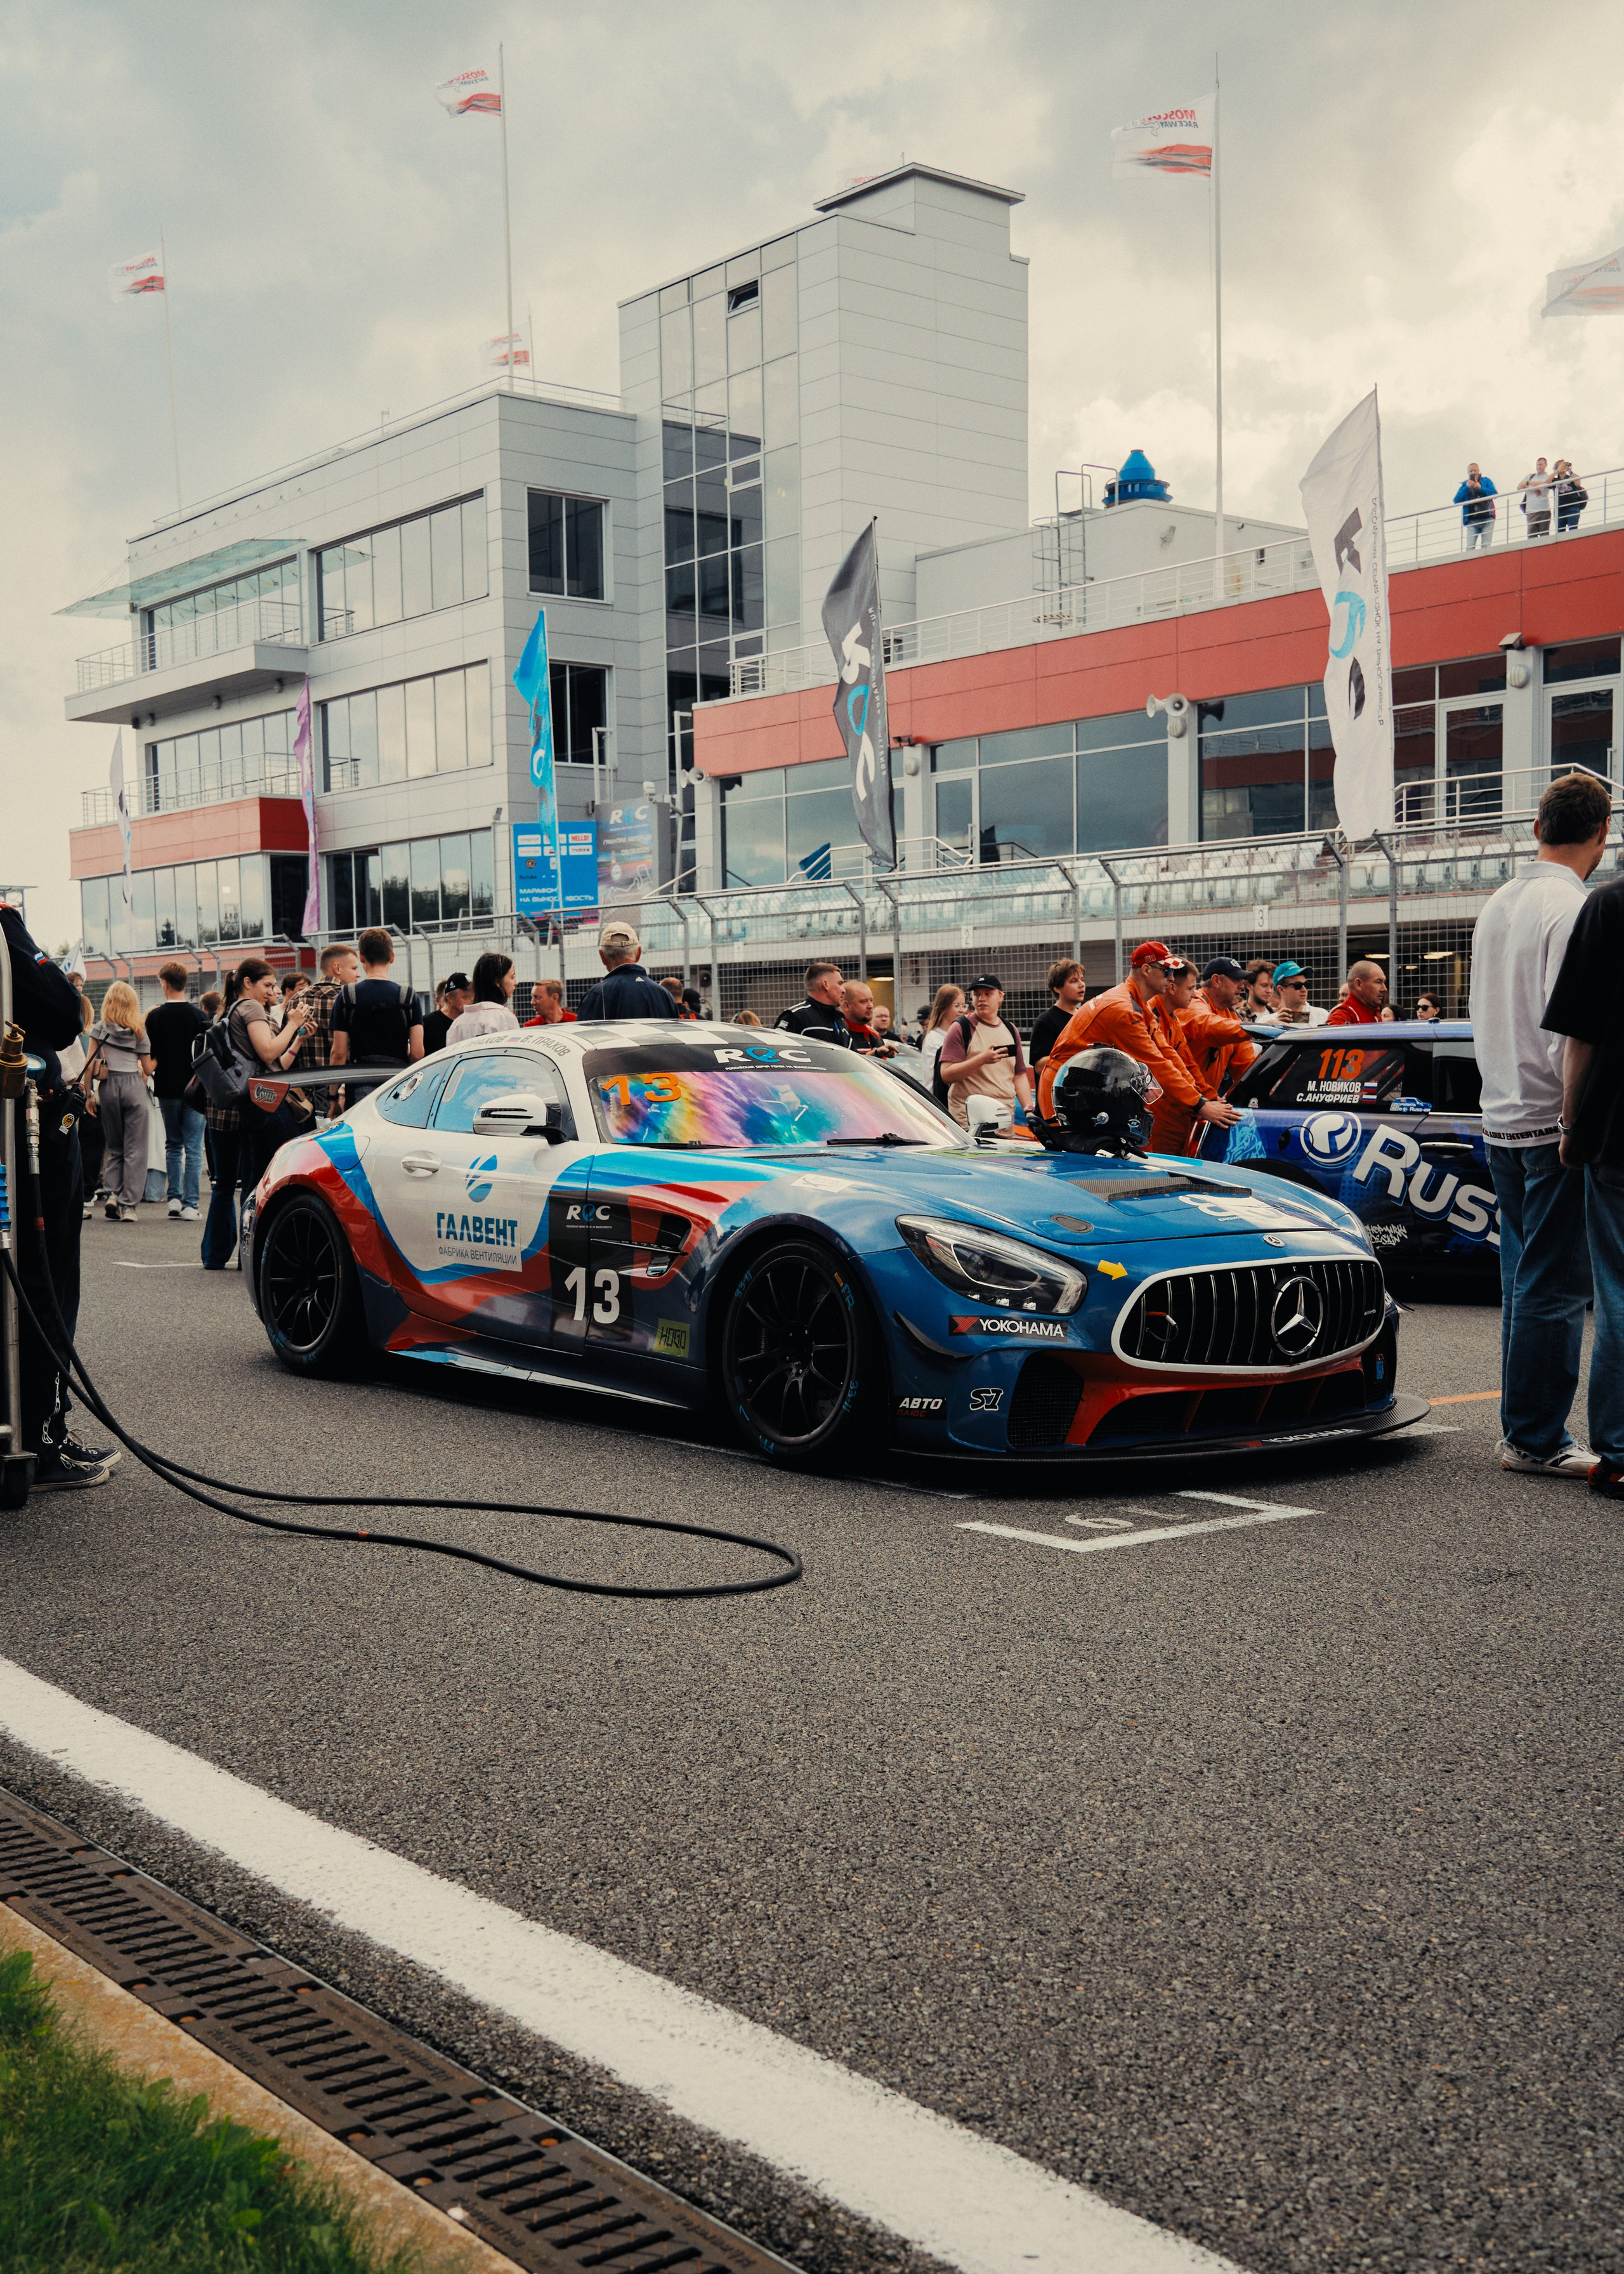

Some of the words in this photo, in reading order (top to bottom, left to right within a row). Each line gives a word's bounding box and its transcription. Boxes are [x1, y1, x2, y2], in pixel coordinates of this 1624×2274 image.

[1257, 910, 1264, 927] 3
[1318, 1049, 1365, 1079] 113
[602, 1072, 682, 1107] 13
[1319, 1081, 1361, 1093] НОВИКОВ
[1489, 1131, 1505, 1140] ADULT
[436, 1213, 518, 1247] ГАЛВЕНТ
[438, 1246, 469, 1260] ФАБРИКА
[471, 1250, 518, 1266] ВЕНТИЛЯЦИИ
[564, 1267, 620, 1325] 13
[979, 1318, 1064, 1337] YOKOHAMA
[899, 1397, 943, 1410] АВТО
[896, 1409, 927, 1417] ПЛЮС
[1262, 1428, 1363, 1443] YOKOHAMA
